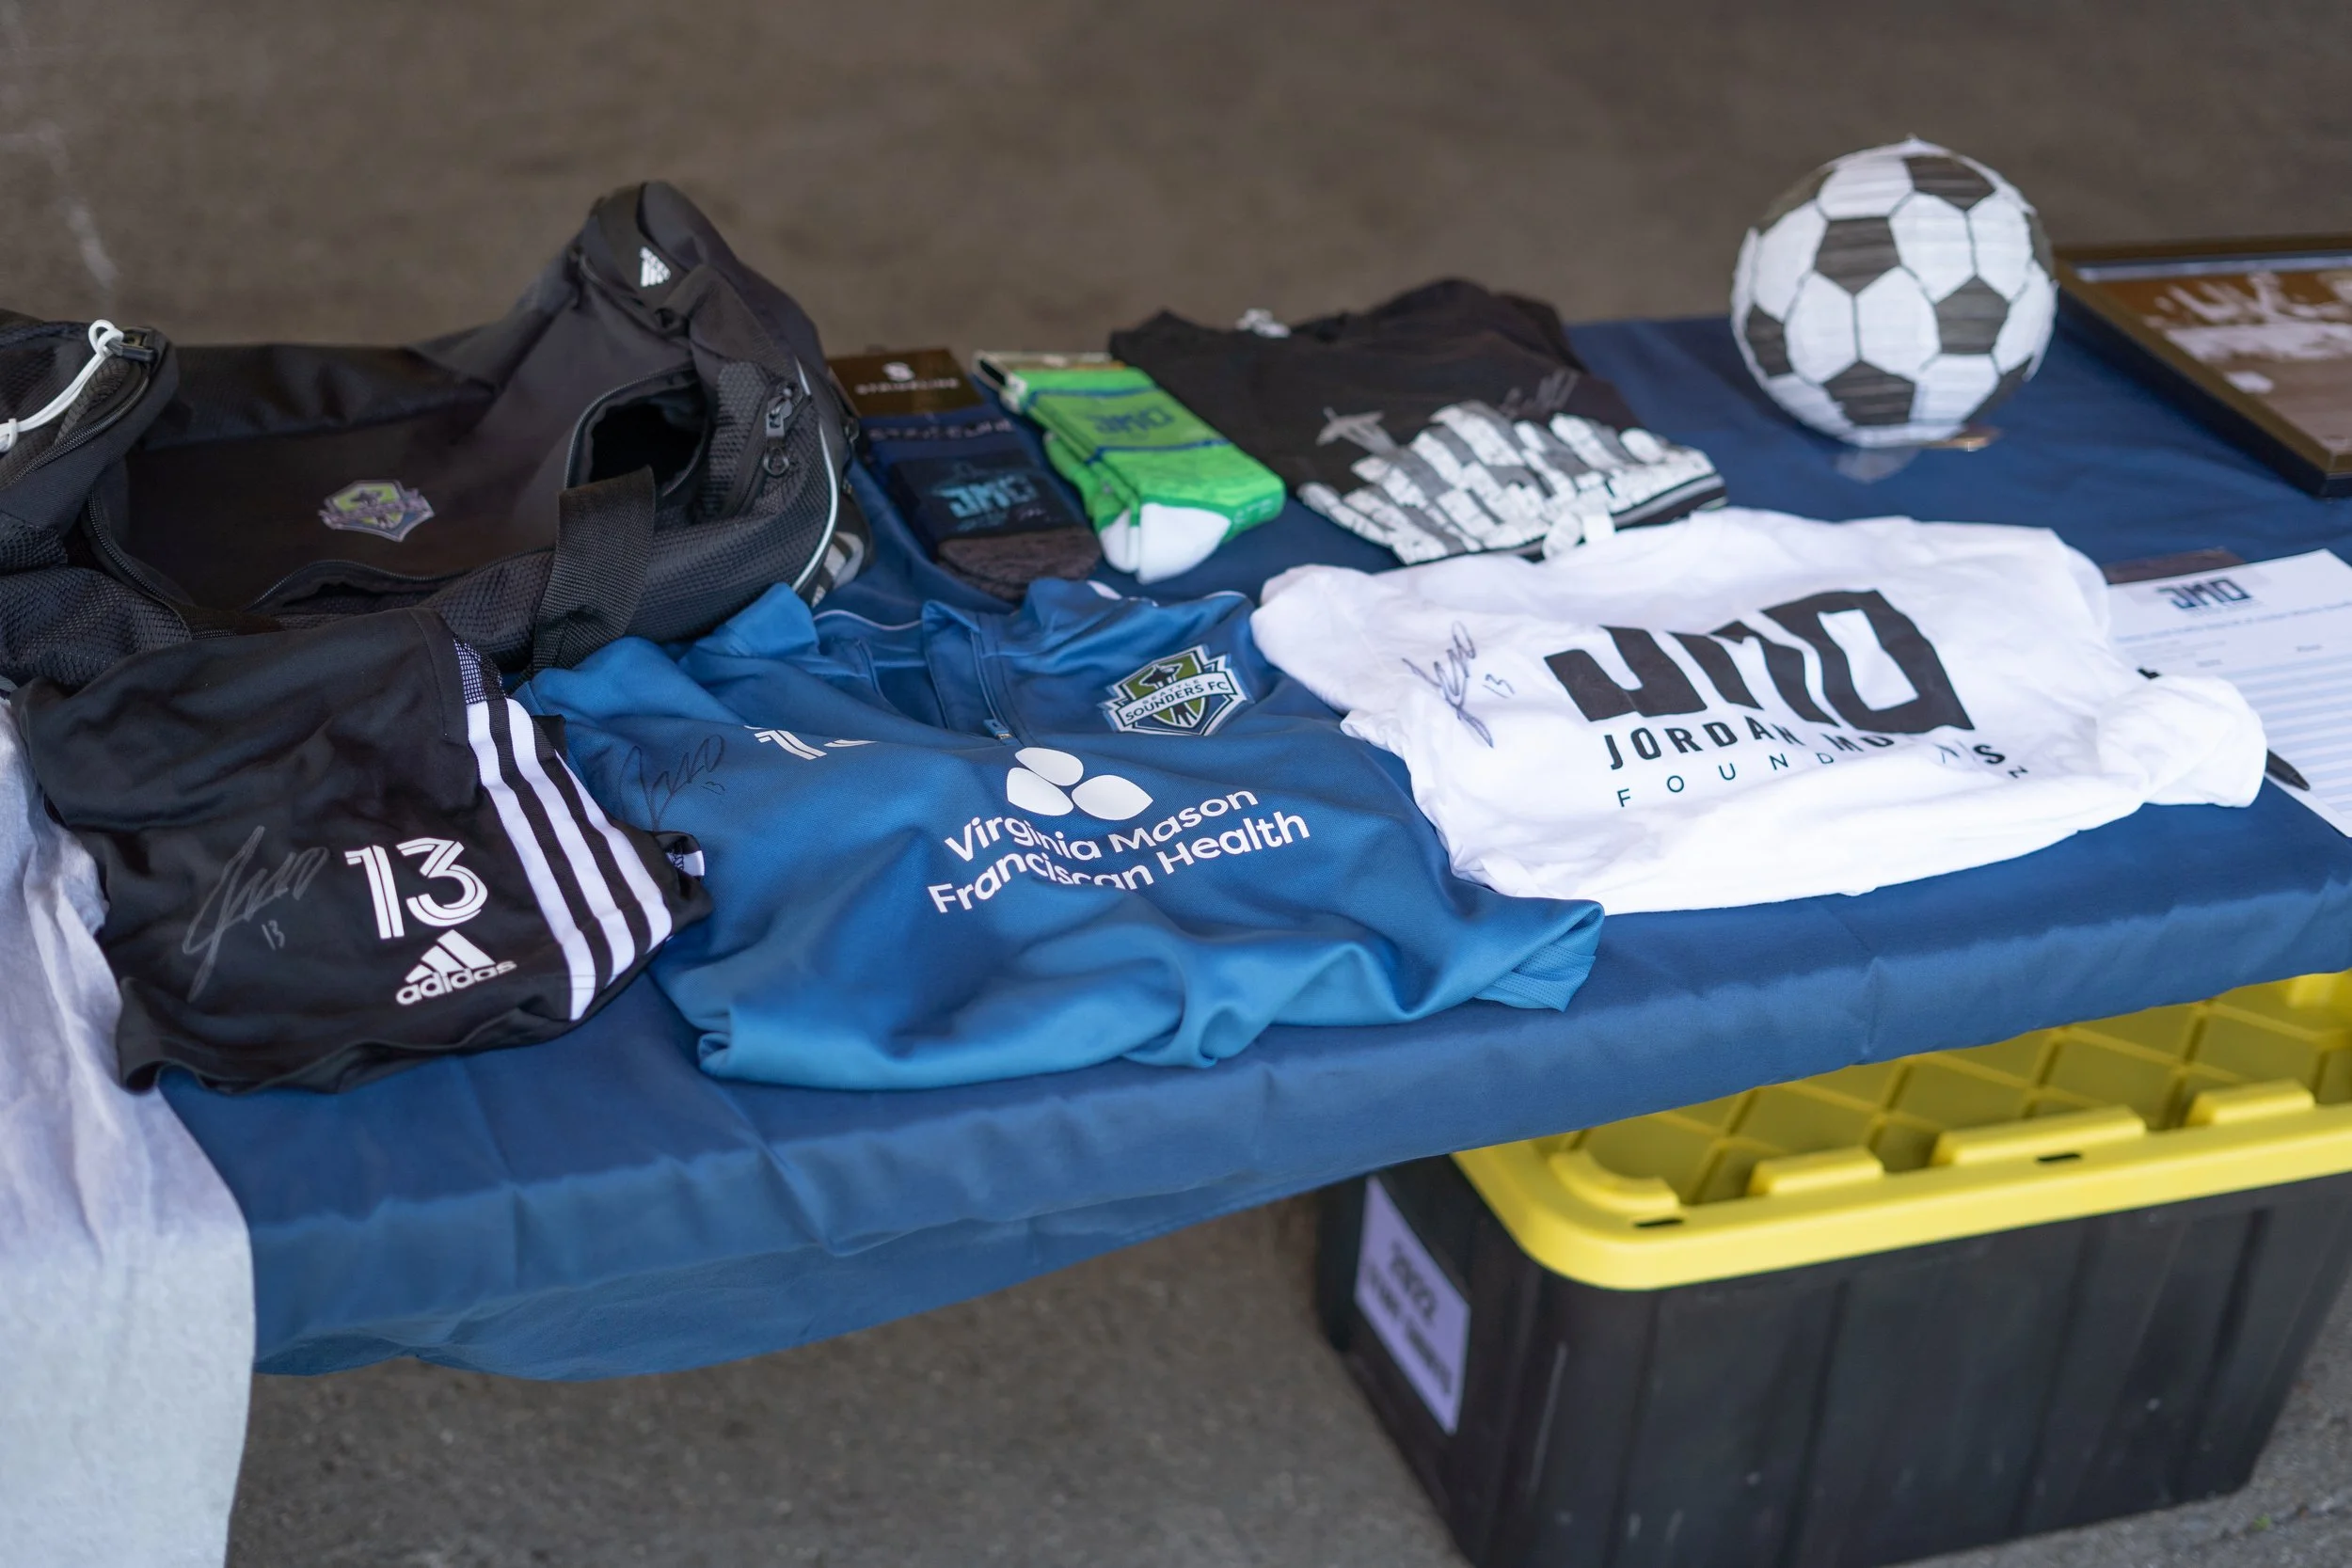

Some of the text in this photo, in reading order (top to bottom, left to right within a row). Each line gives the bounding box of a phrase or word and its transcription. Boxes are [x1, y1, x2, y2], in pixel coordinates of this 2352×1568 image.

[2156, 578, 2252, 610] JMO
[1124, 680, 1230, 721] SOUNDERS FC
[1604, 716, 1806, 770] JORDAN
[944, 790, 1259, 863] Virginia Mason
[1156, 810, 1311, 875] Health
[344, 836, 488, 940] 13
[262, 919, 285, 950] 13
[395, 959, 518, 1006] adidas
